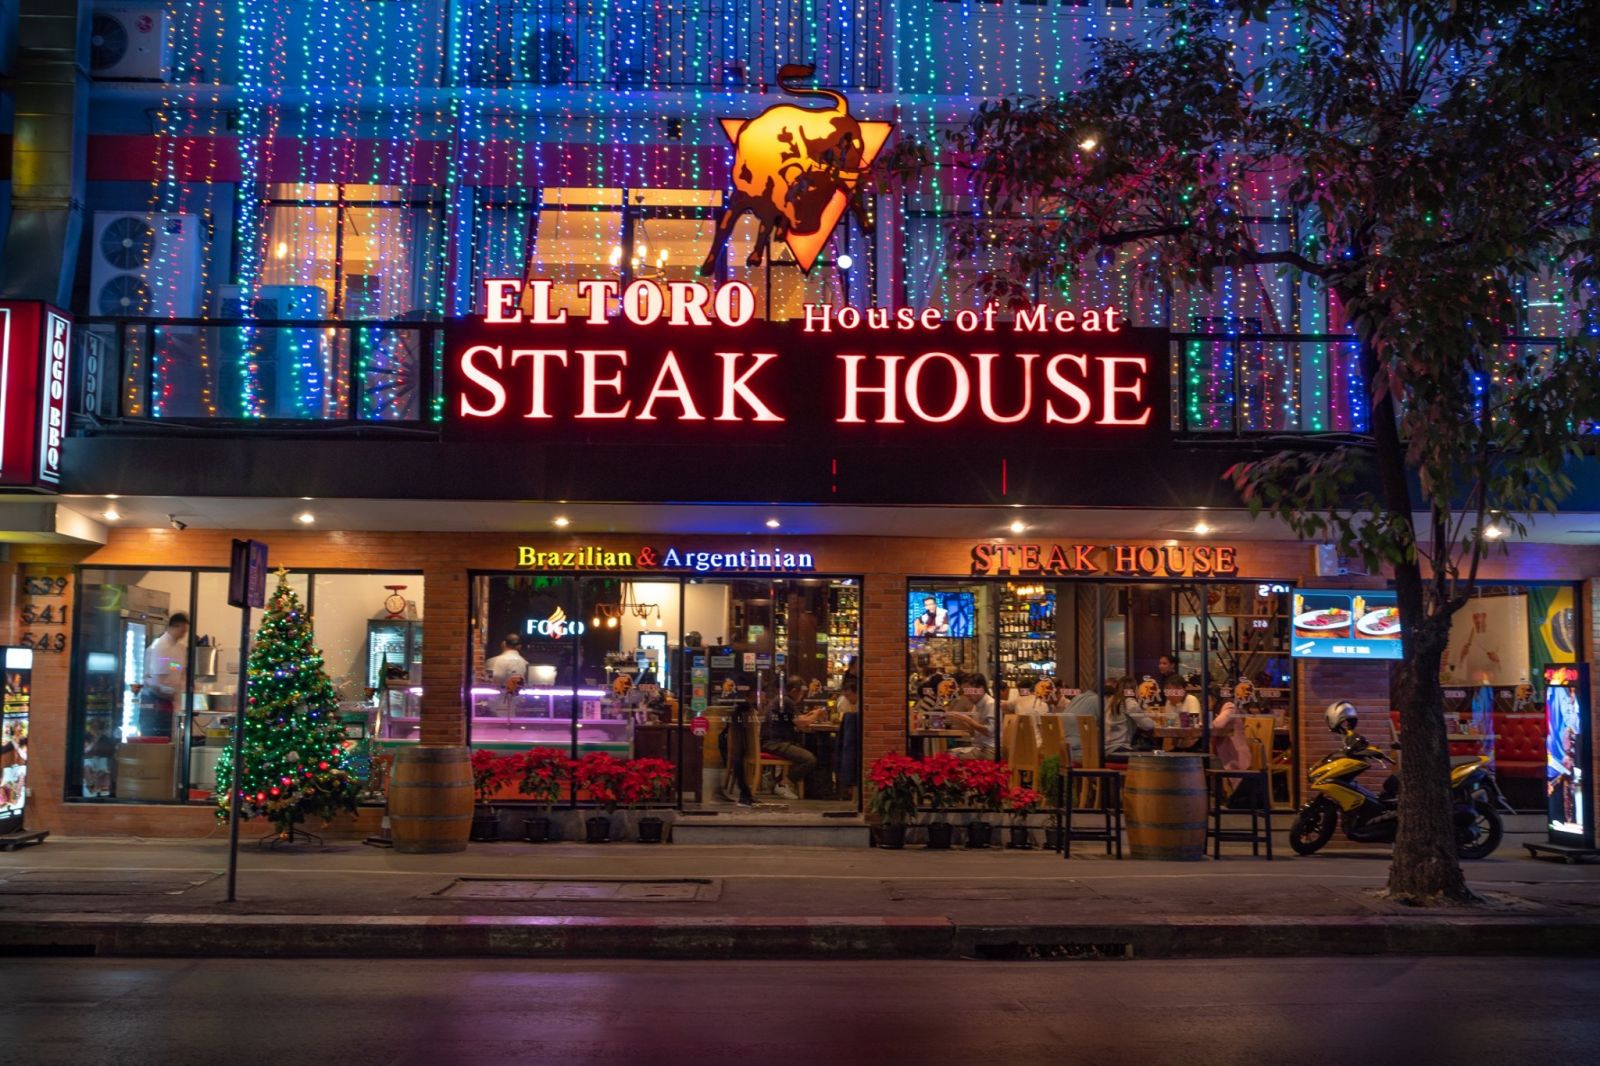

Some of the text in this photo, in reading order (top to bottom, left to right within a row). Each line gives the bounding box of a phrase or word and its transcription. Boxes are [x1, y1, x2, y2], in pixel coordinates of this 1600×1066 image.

[483, 279, 756, 327] EL TORO
[803, 301, 1121, 332] House of Meat
[48, 319, 65, 470] FOGO BBQ
[460, 345, 1152, 425] STEAK HOUSE
[518, 546, 814, 571] Brazilian & Argentinian
[973, 544, 1237, 574] STEAK HOUSE
[20, 604, 68, 624] 541
[527, 619, 585, 636] FOGO
